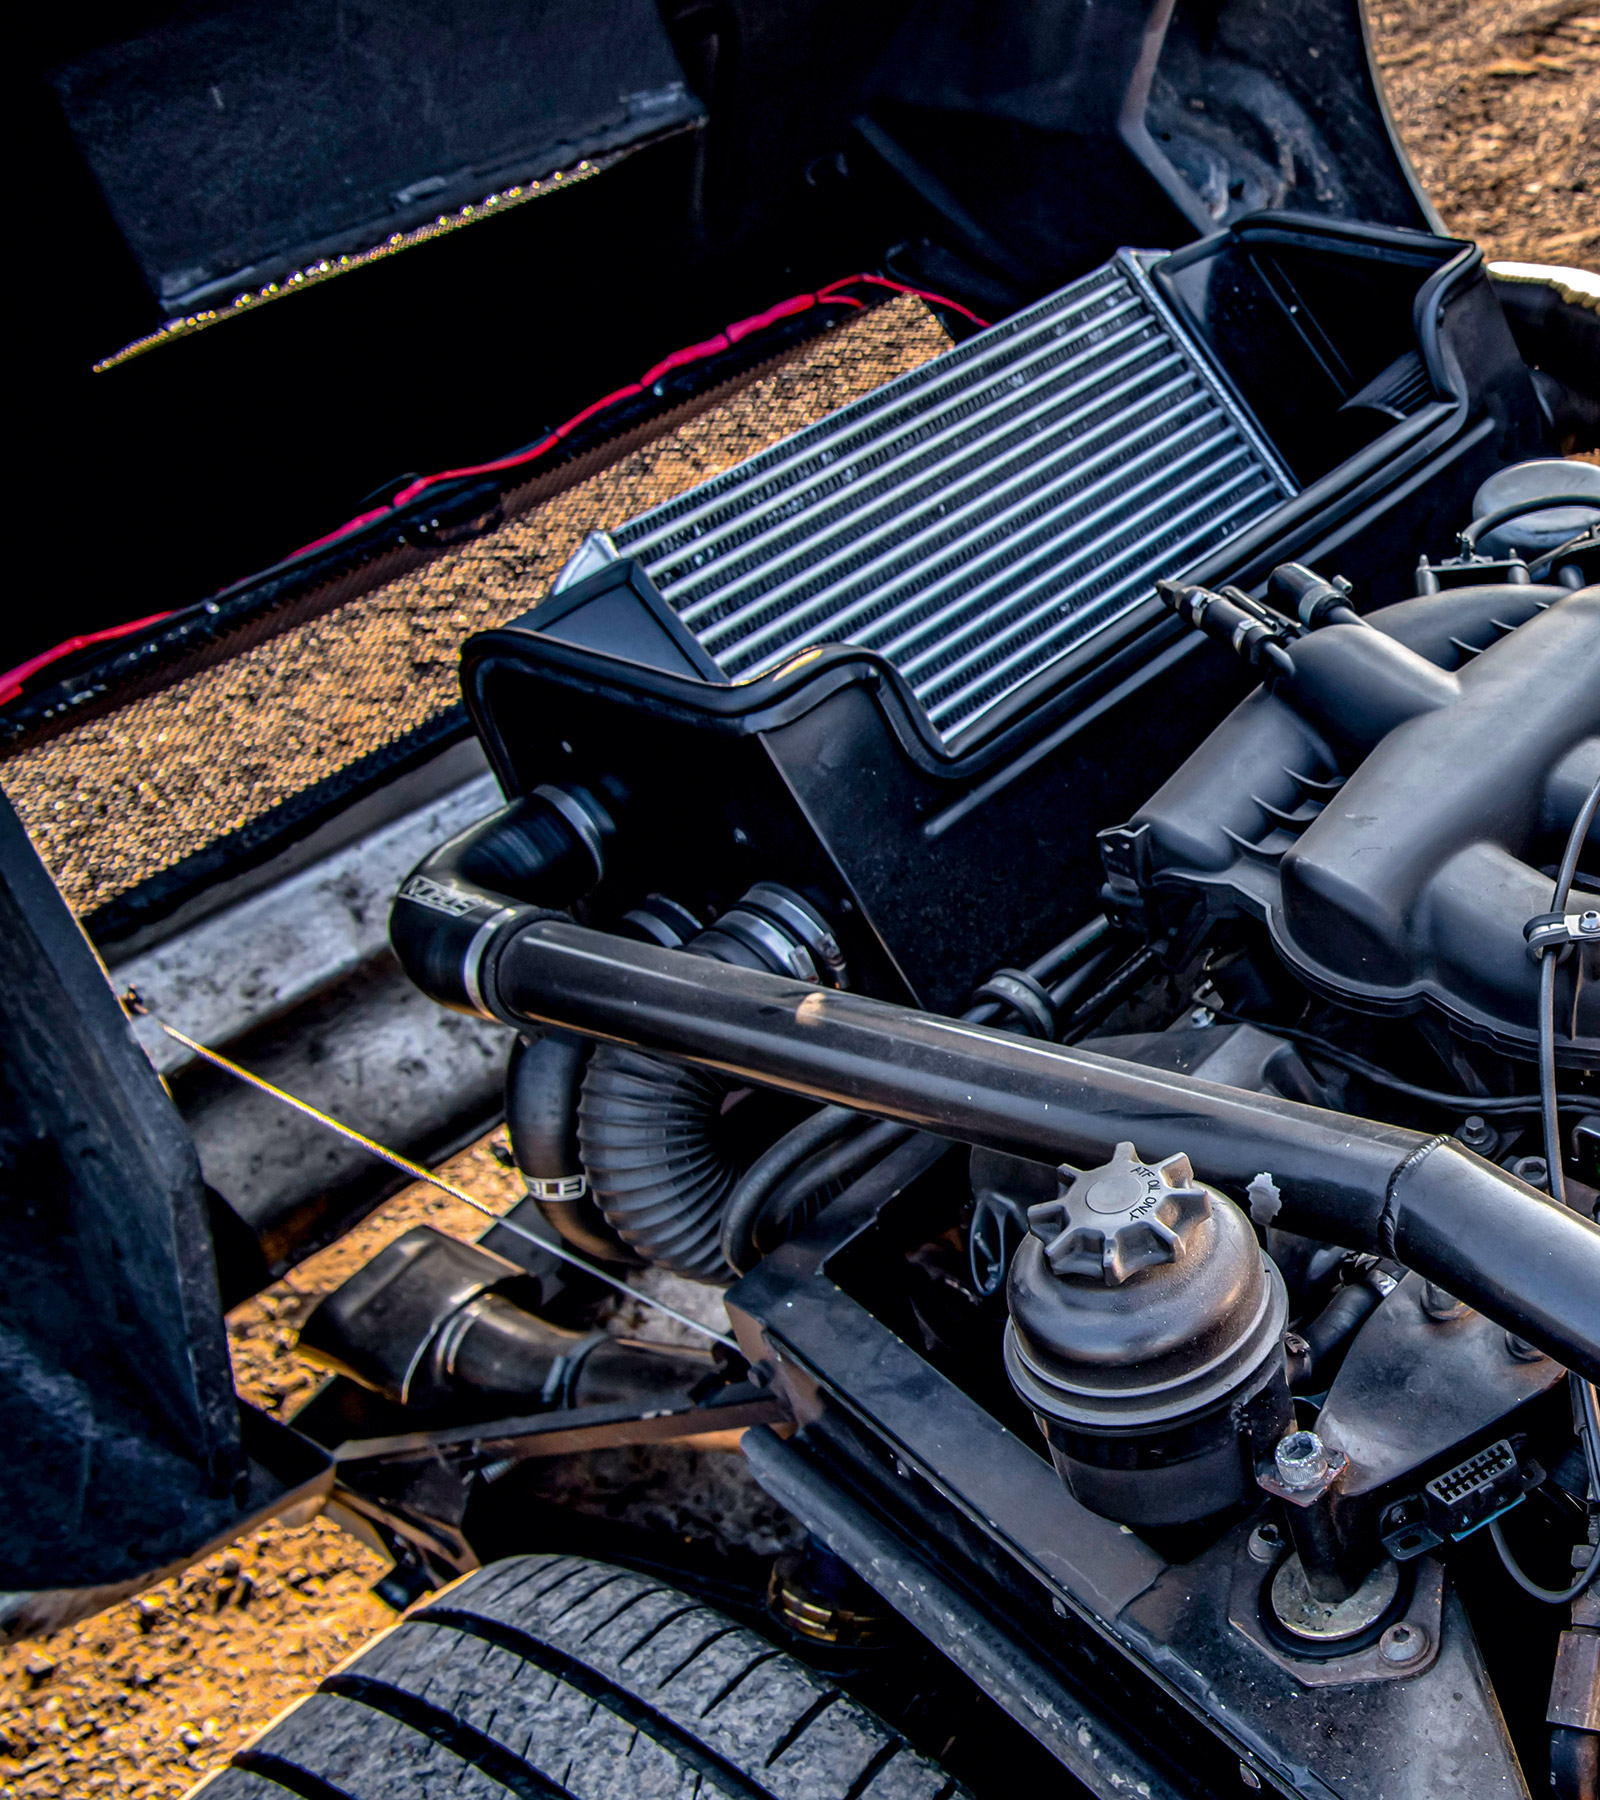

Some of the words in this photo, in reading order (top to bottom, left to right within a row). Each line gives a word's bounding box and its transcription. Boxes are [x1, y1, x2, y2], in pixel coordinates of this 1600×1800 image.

[1130, 1166, 1155, 1178] ATF
[1147, 1179, 1161, 1194] OIL
[1129, 1196, 1157, 1222] ONLY
